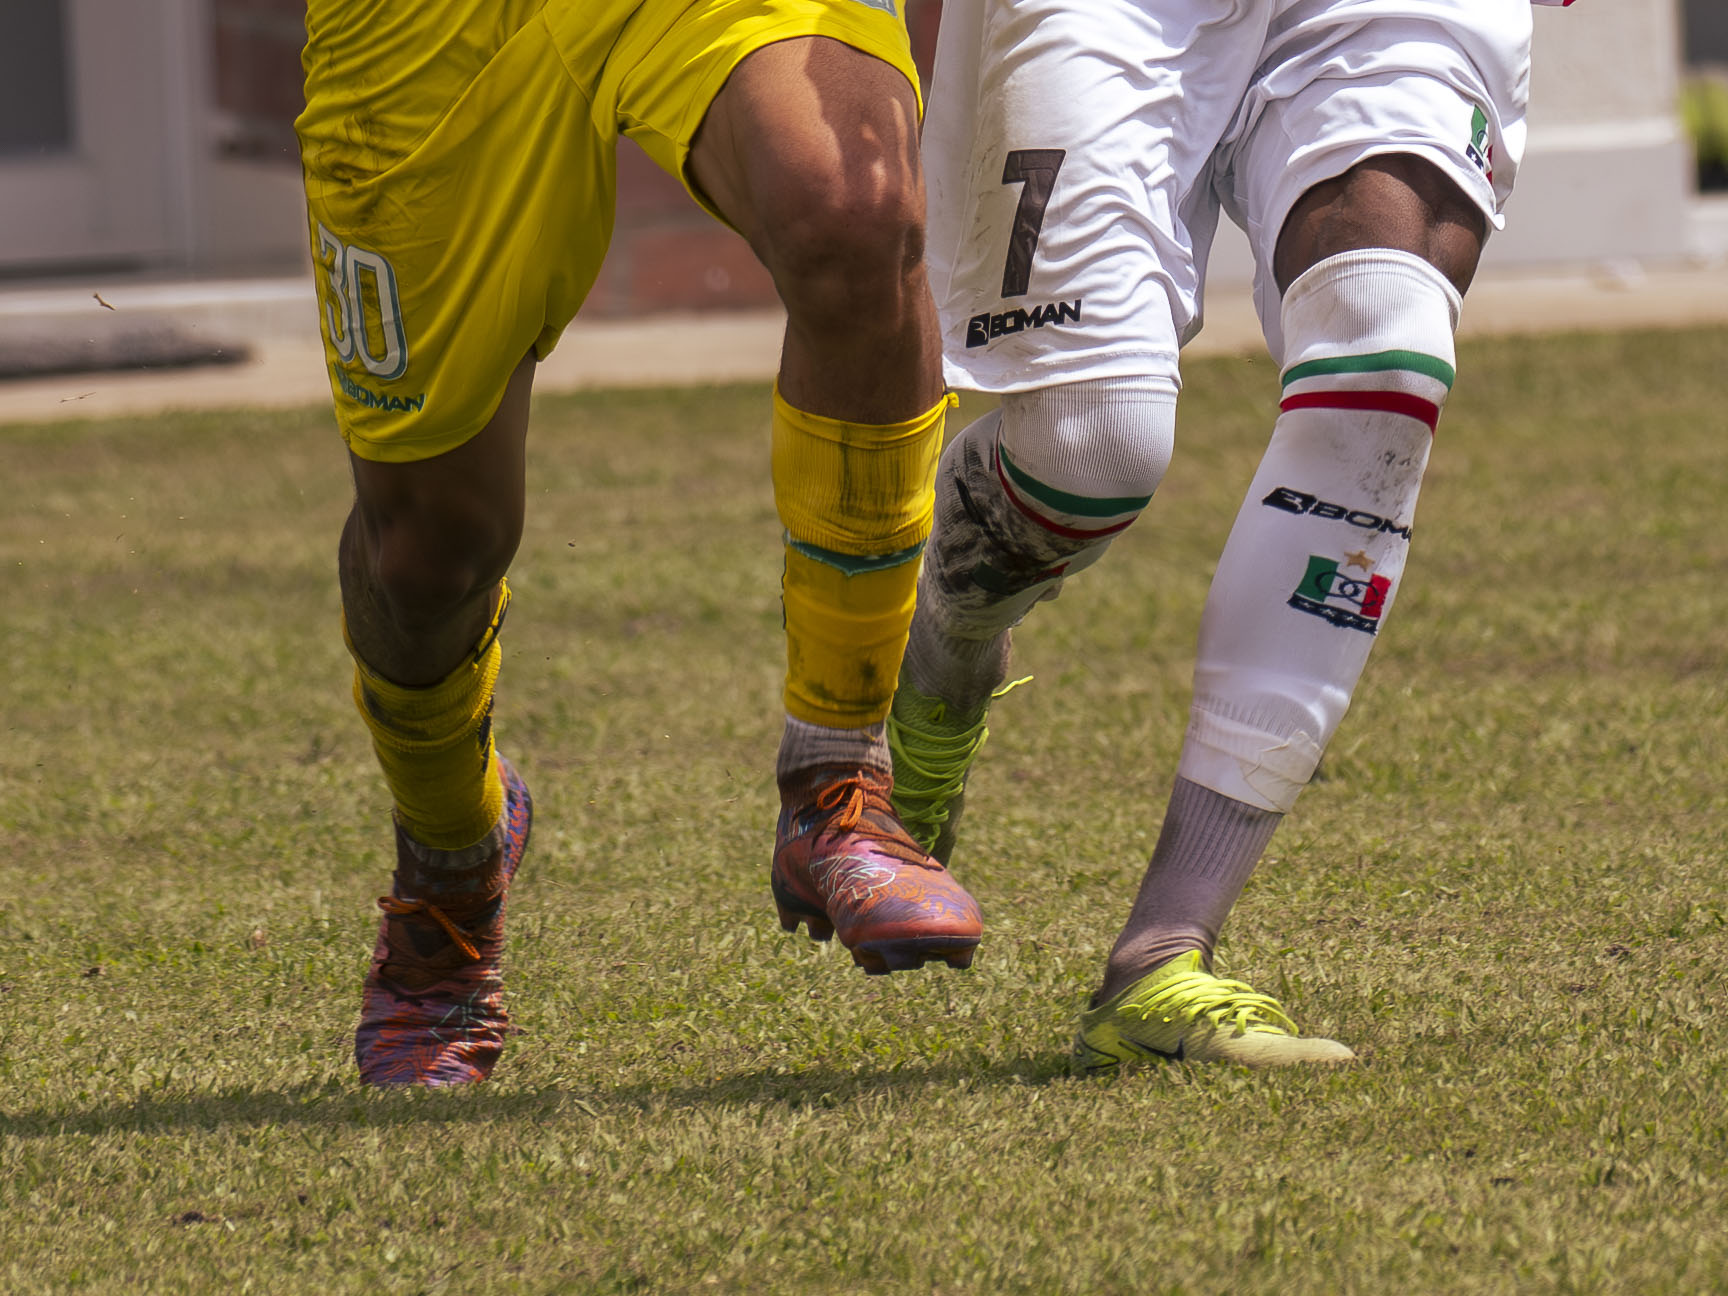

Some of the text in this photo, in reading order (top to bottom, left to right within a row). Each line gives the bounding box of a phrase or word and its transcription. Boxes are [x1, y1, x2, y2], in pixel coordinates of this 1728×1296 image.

[1001, 149, 1067, 298] 7
[318, 222, 409, 381] 30
[989, 298, 1082, 340] BOMAN
